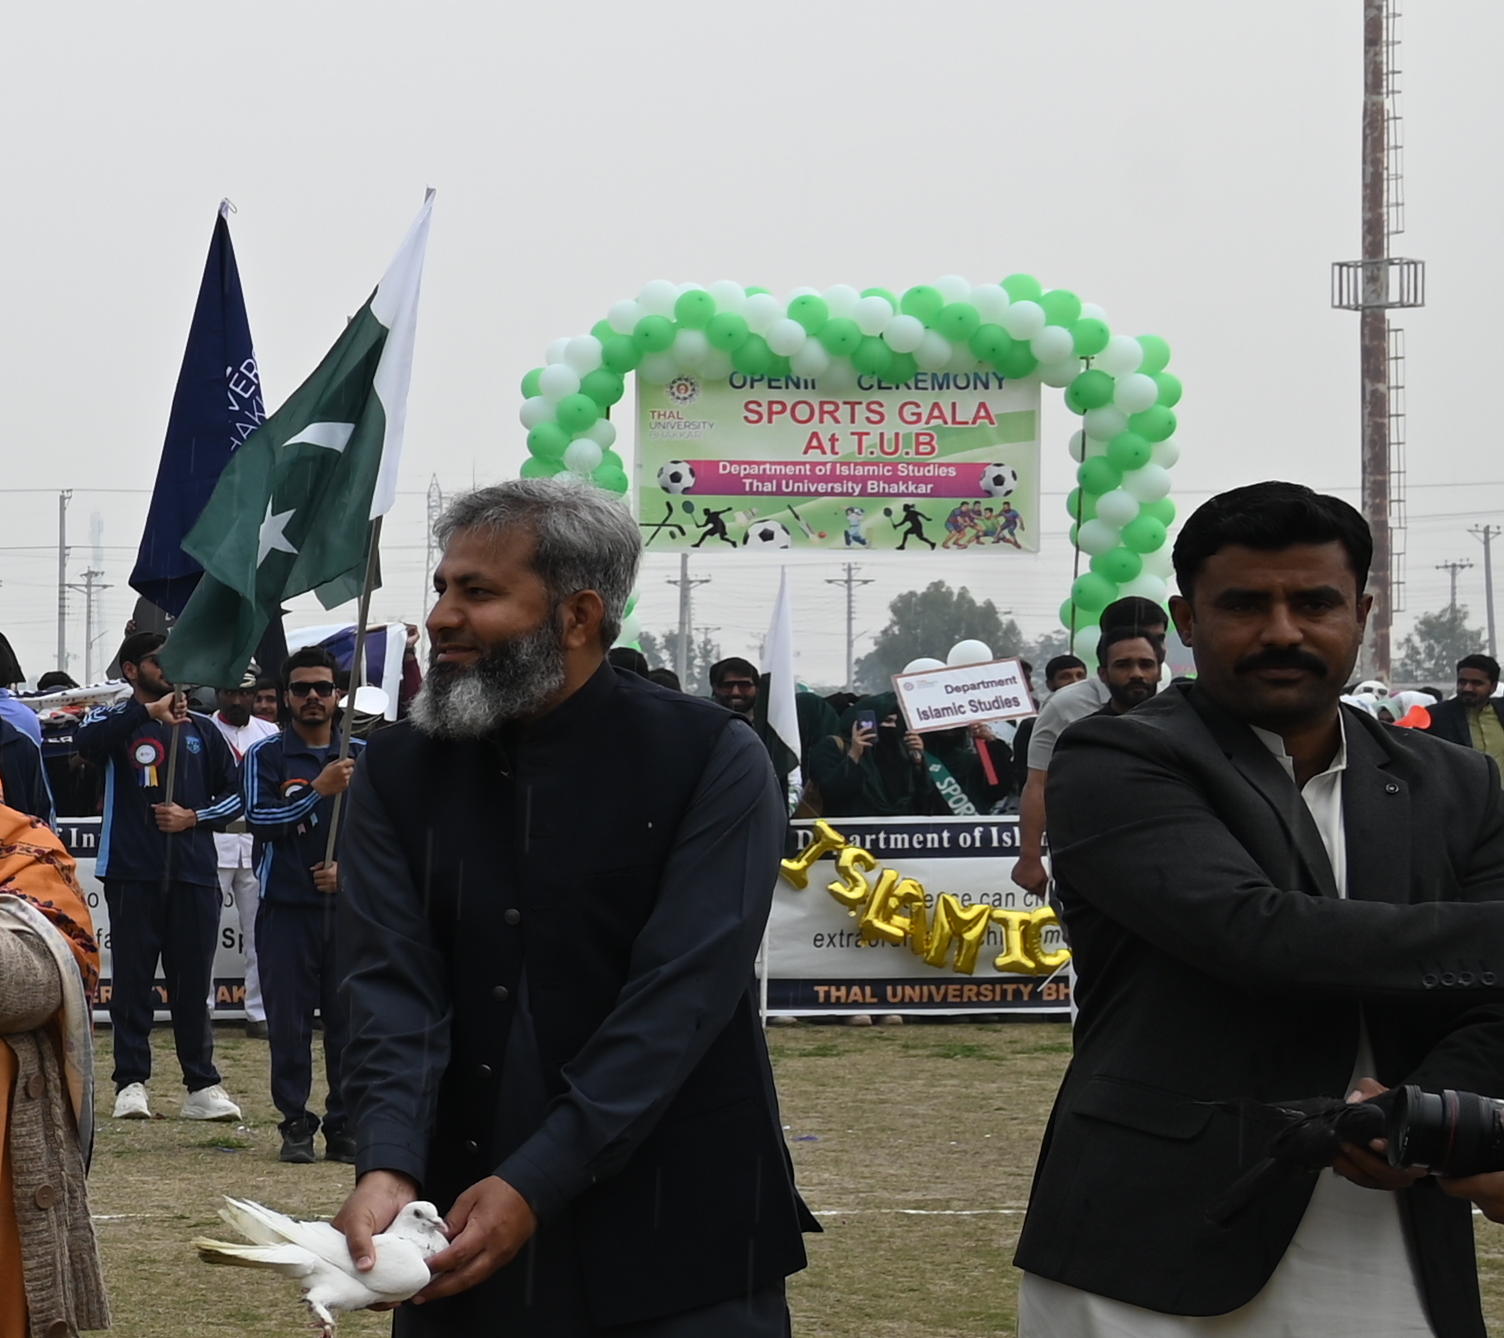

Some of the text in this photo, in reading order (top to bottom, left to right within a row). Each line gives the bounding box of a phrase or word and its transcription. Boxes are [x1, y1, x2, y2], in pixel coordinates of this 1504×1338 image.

[649, 410, 683, 420] THAL
[743, 399, 996, 426] SPORTS GALA
[649, 421, 715, 430] UNIVERSITY
[802, 431, 937, 457] At T.U.B
[718, 461, 957, 477] Department of Islamic Studies
[742, 478, 934, 496] Thal University Bhakkar
[944, 675, 1018, 695] Department
[916, 695, 1021, 721] Islamic Studies
[957, 827, 984, 848] of
[780, 819, 1072, 977] ISLAMIC
[980, 892, 1016, 907] can
[813, 986, 878, 1003] THAL
[885, 984, 1034, 1003] UNIVERSITY
